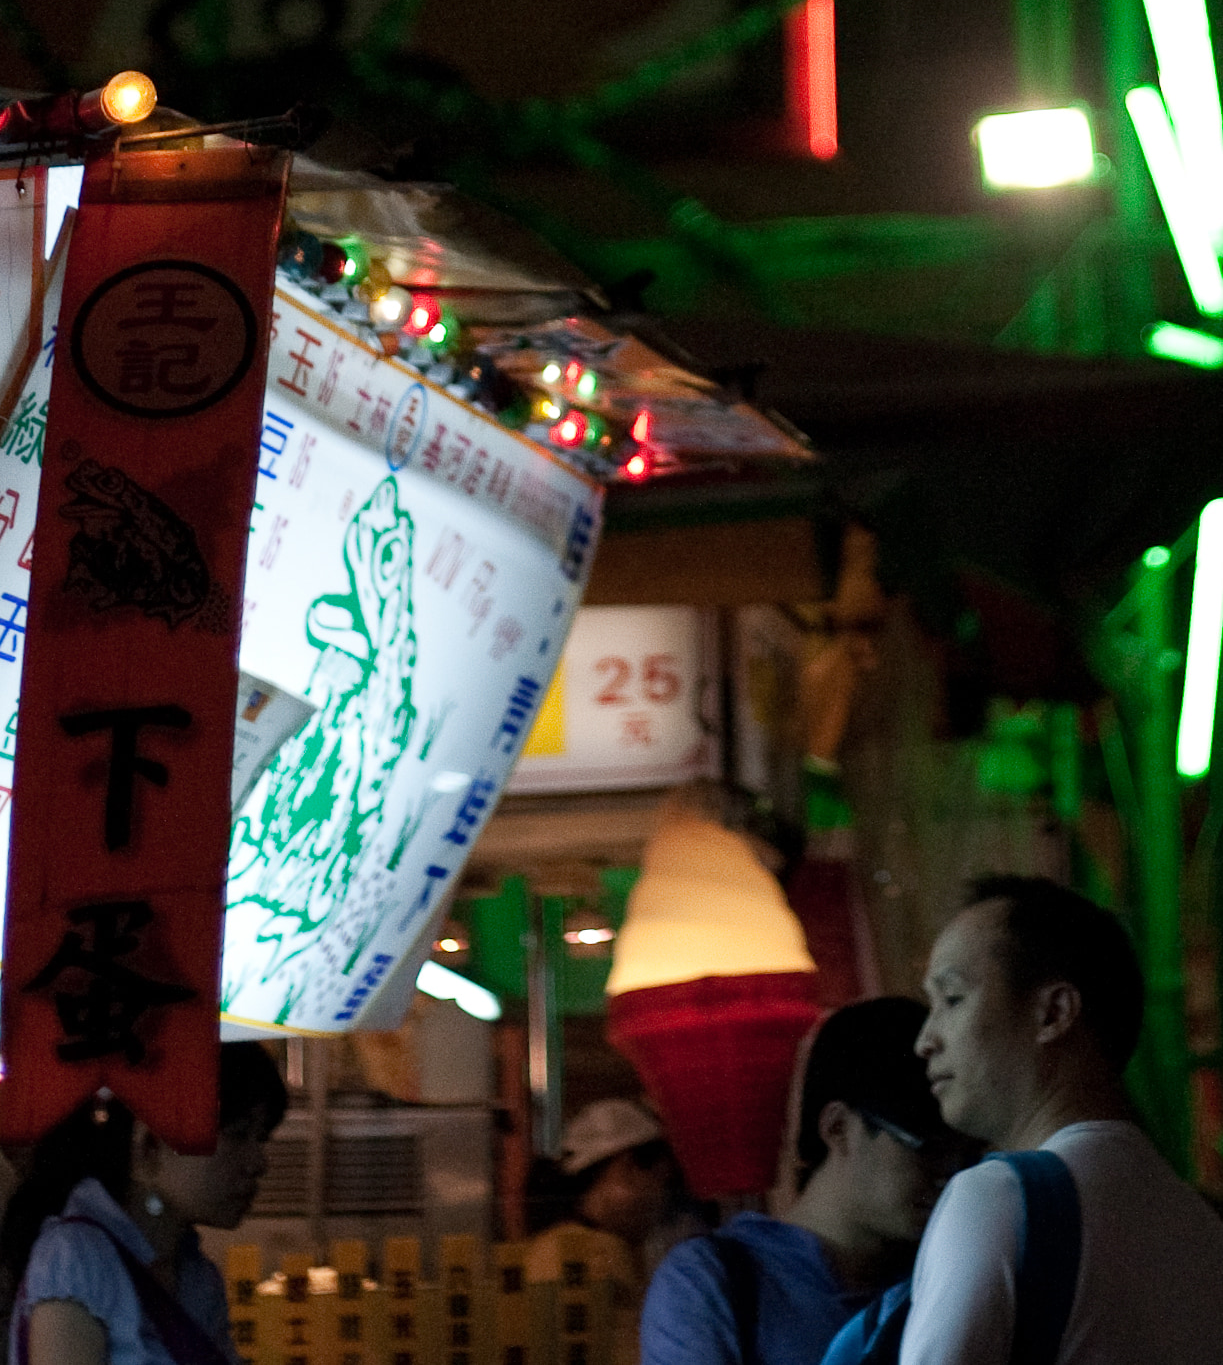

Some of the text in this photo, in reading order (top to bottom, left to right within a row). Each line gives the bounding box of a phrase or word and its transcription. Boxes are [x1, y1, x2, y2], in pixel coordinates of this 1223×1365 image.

[117, 280, 220, 399] 王記
[594, 654, 680, 706] 25
[20, 705, 199, 1067] 下蛋
